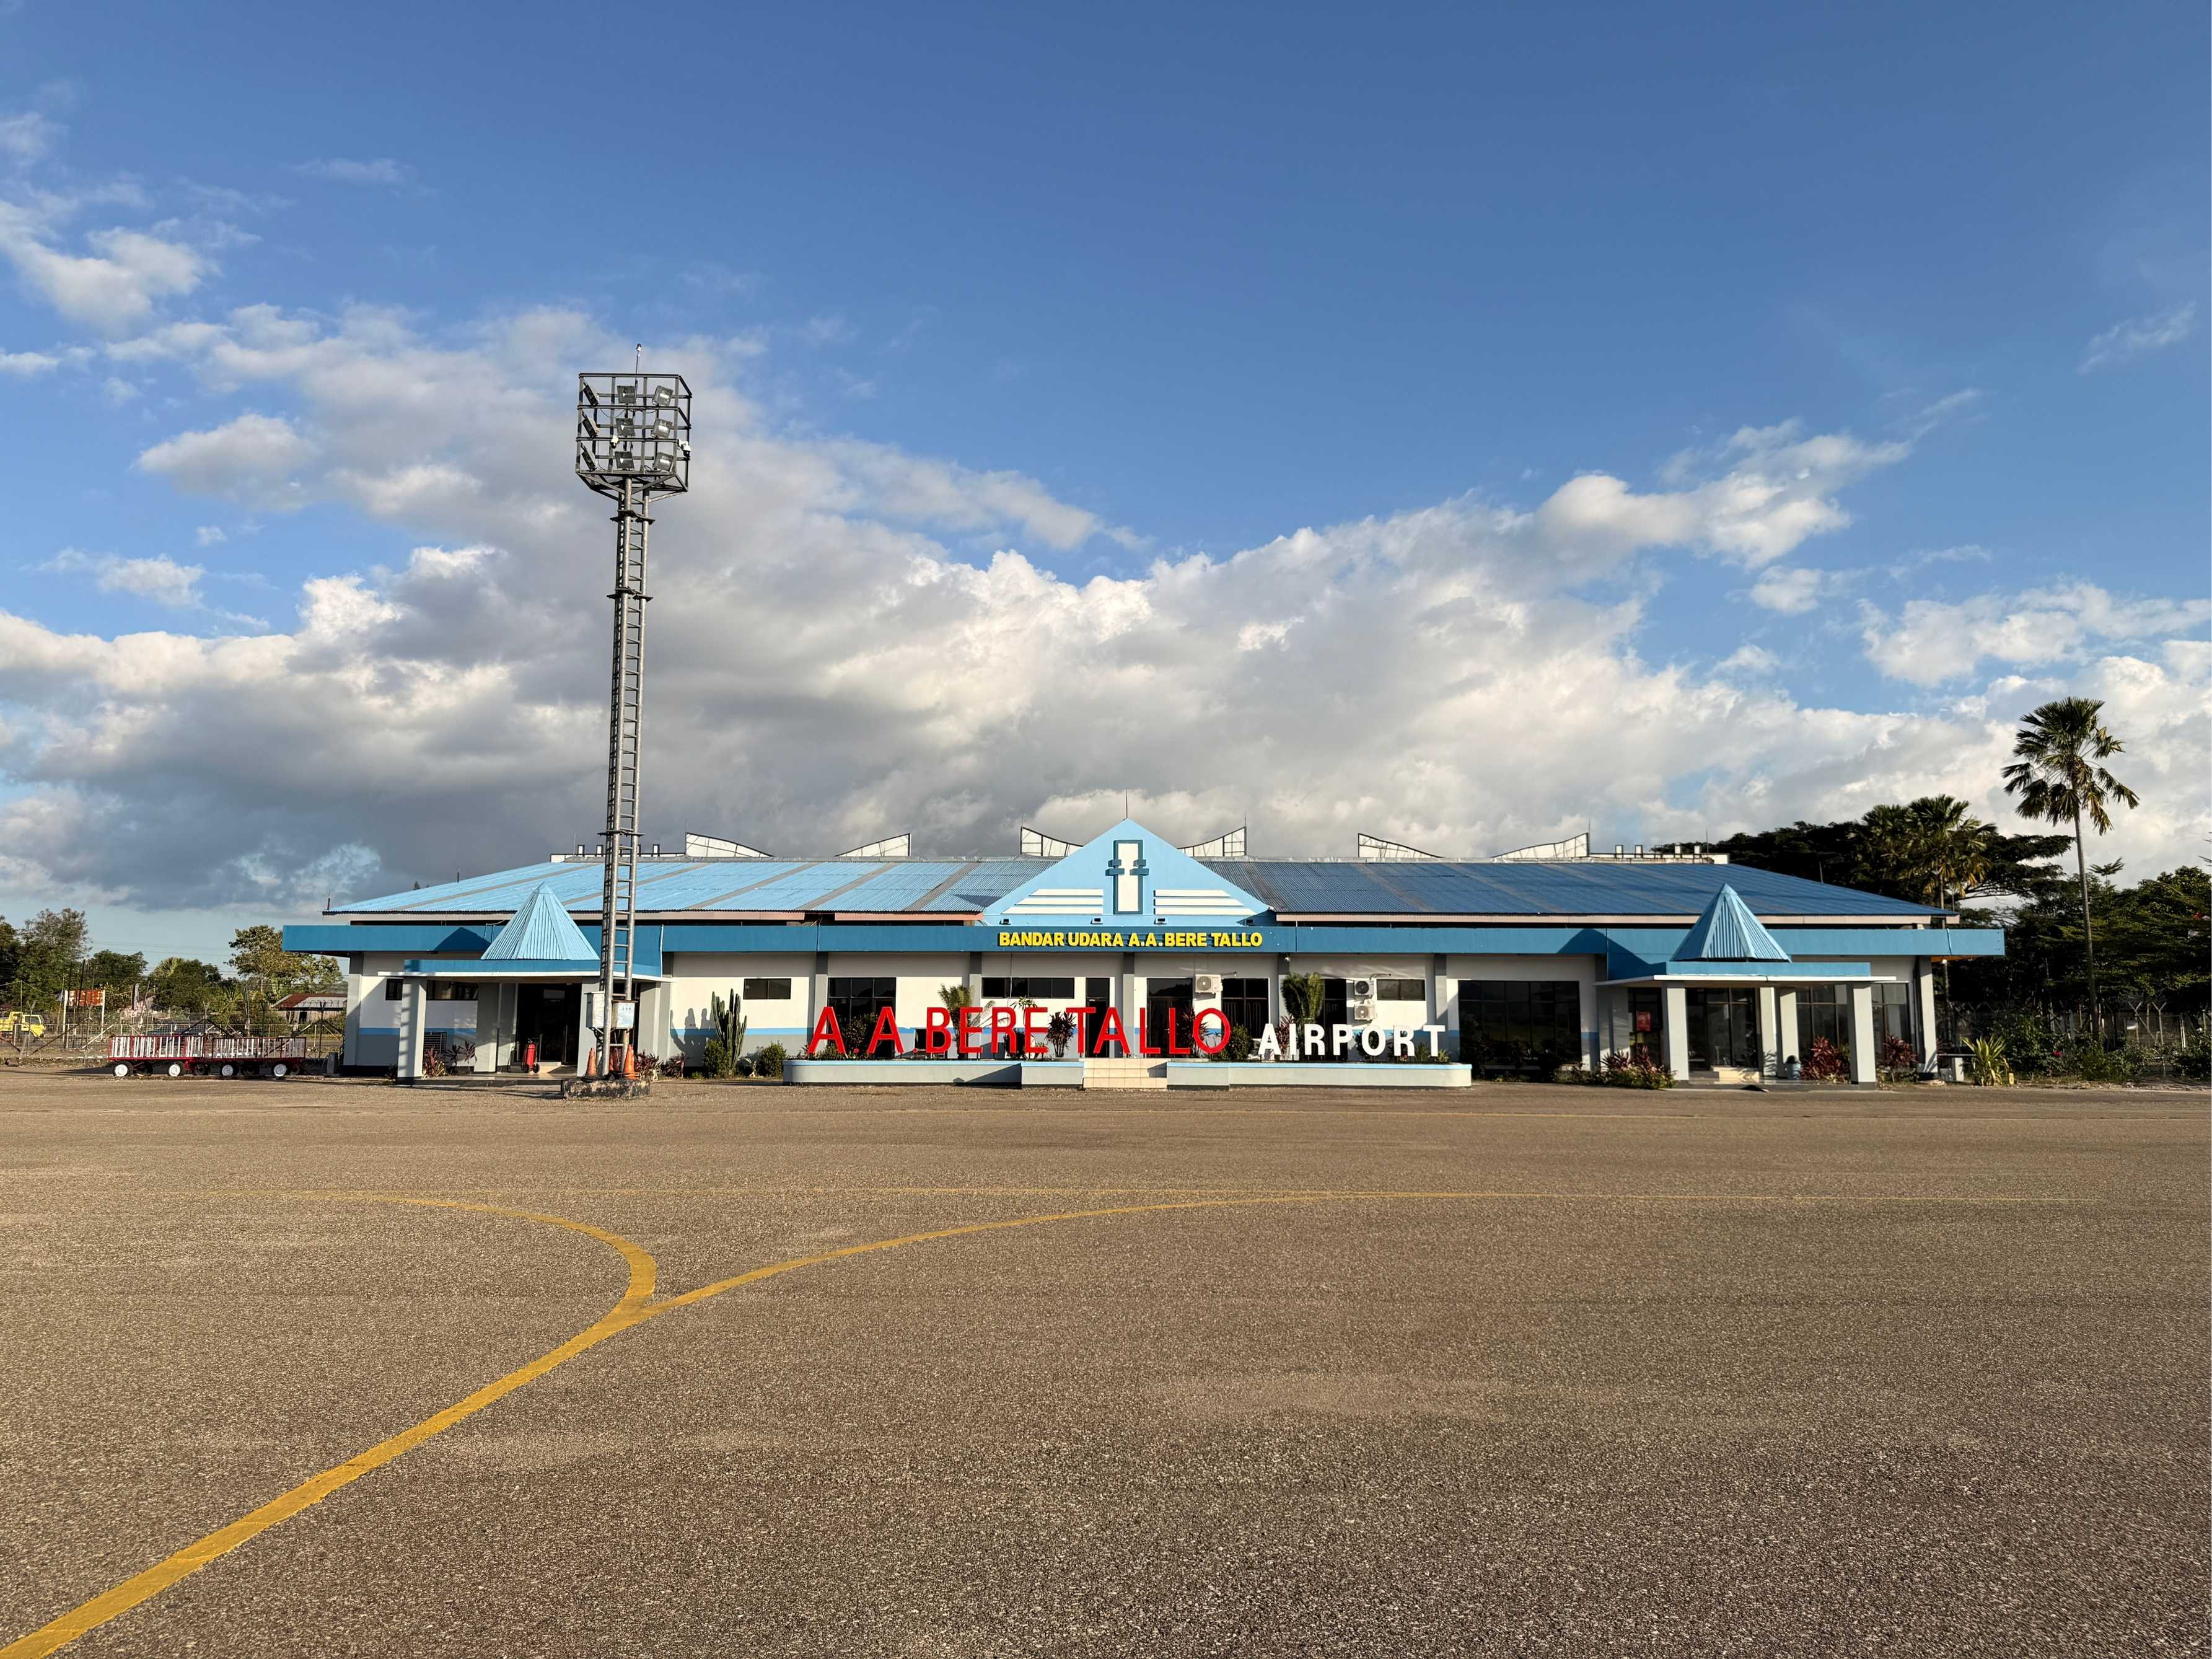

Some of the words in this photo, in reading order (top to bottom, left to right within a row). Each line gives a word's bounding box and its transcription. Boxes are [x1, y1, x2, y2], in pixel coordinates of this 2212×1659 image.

[999, 931, 1065, 947] BANDAR
[1068, 931, 1124, 947] UDARA
[1211, 931, 1263, 947] TALLO
[1065, 1006, 1232, 1054] TALLO
[1258, 1023, 1446, 1057] AIRPORT
